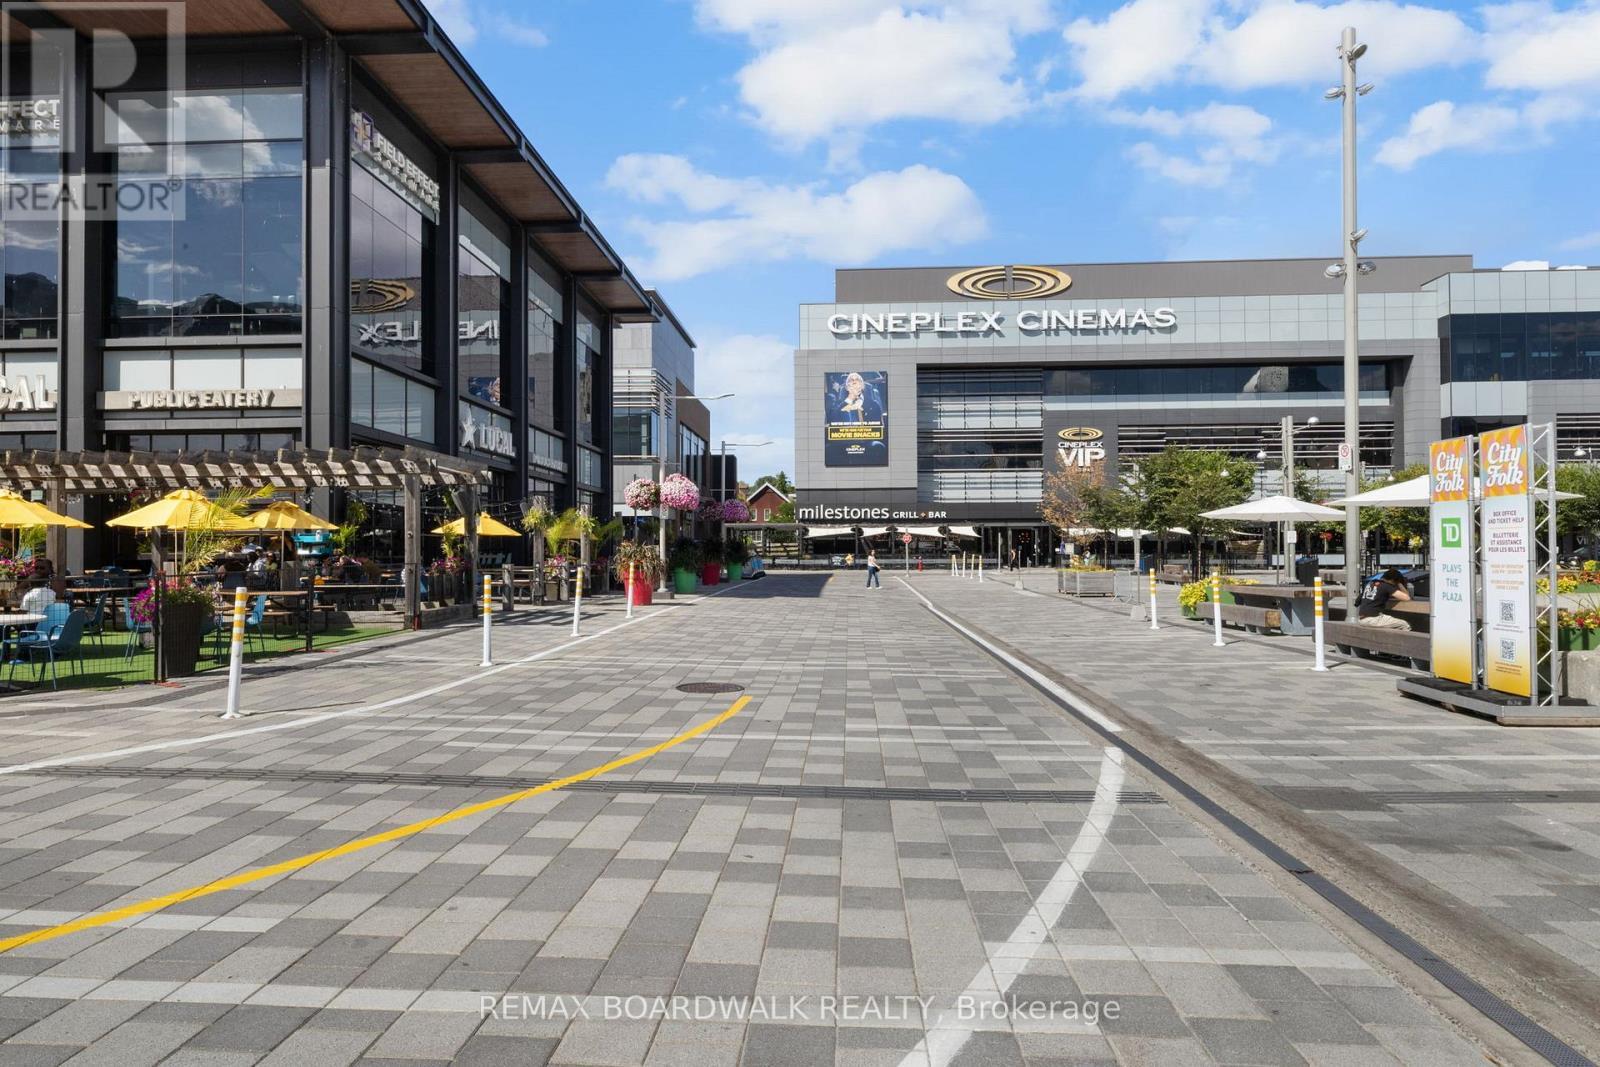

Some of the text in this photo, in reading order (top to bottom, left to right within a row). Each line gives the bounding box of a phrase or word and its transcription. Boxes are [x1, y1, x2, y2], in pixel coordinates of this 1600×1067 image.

[374, 133, 440, 198] FIELD EFFECT
[827, 307, 1177, 334] CINEPLEX CINEMAS
[127, 390, 276, 408] PUBLIC EATERY
[1058, 448, 1105, 467] VIP
[1436, 451, 1465, 472] City
[1487, 442, 1522, 466] City
[1435, 470, 1465, 493] Folk
[1485, 462, 1524, 488] Folk
[799, 504, 947, 519] milestones GRILL BAR
[1442, 564, 1462, 573] PLAYS
[1446, 579, 1459, 588] THE
[1442, 592, 1463, 602] PLAZA
